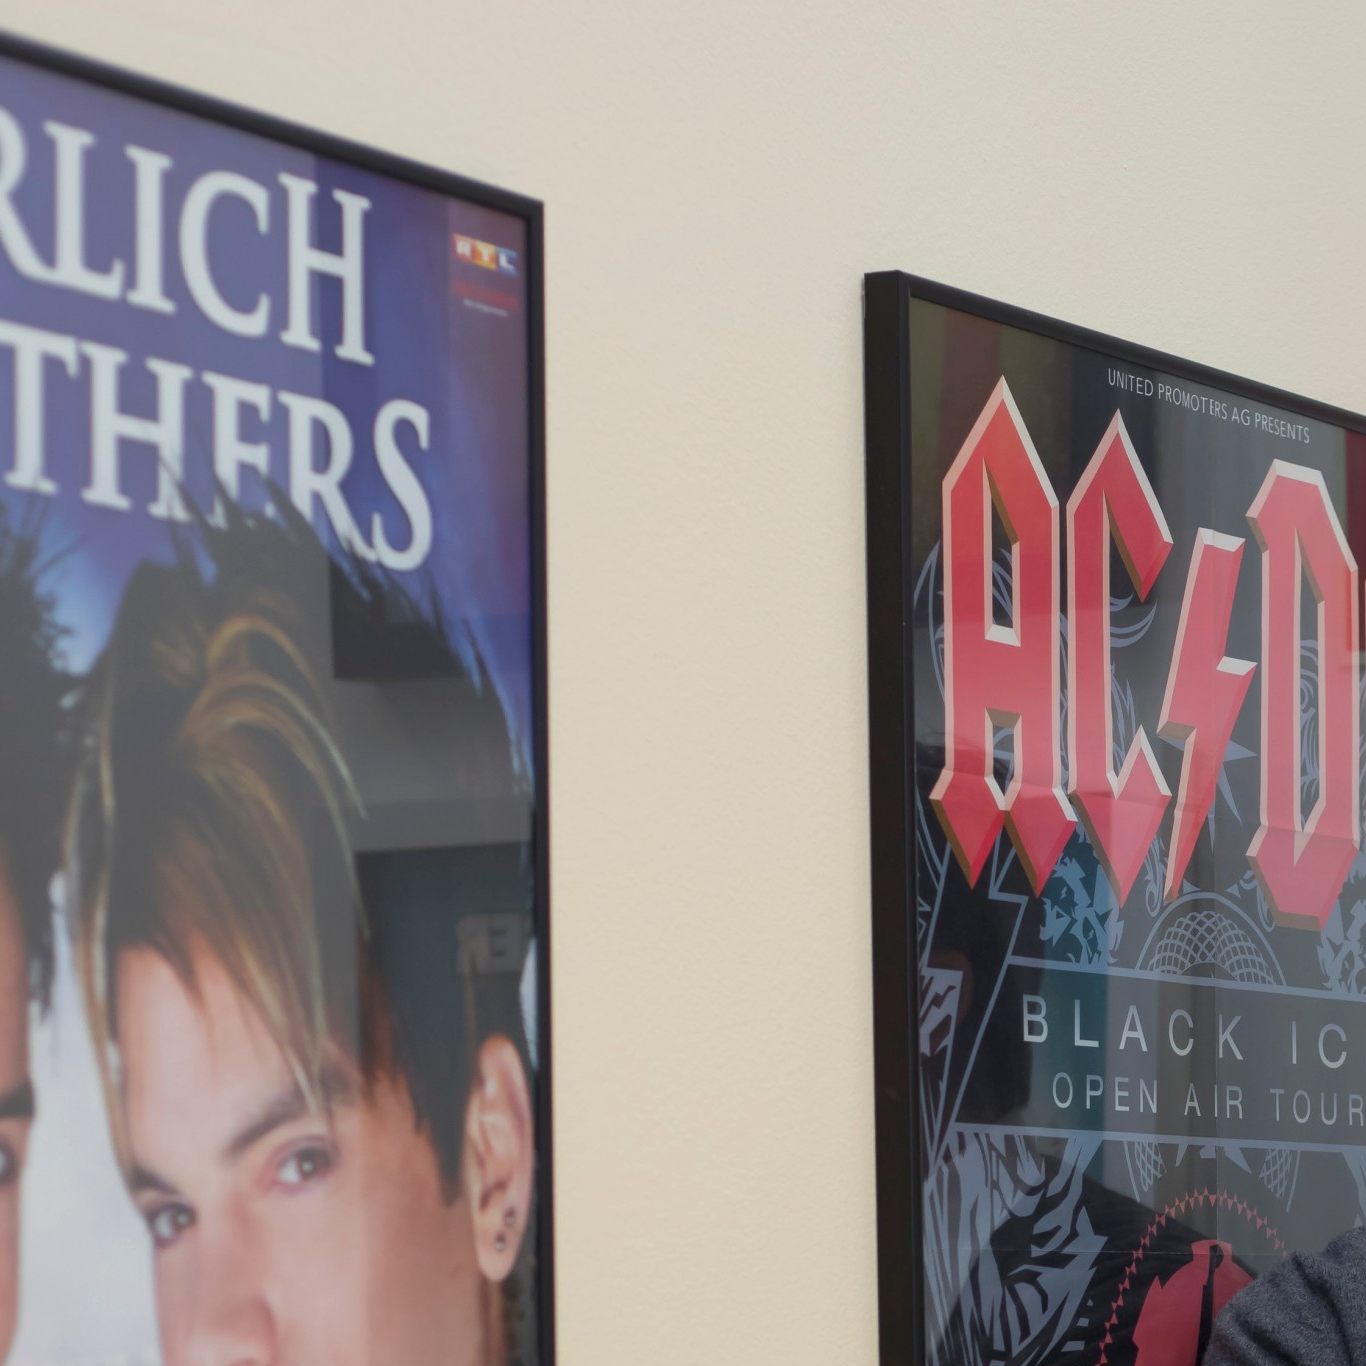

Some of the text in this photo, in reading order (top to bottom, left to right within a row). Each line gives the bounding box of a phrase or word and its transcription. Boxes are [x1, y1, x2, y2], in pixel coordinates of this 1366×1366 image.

[455, 239, 515, 269] RTL
[1108, 367, 1310, 444] UNITED PROMOTERS AG PRESENTS
[1021, 993, 1244, 1062] BLACK
[1052, 1071, 1365, 1127] OPEN AIR TOUR
